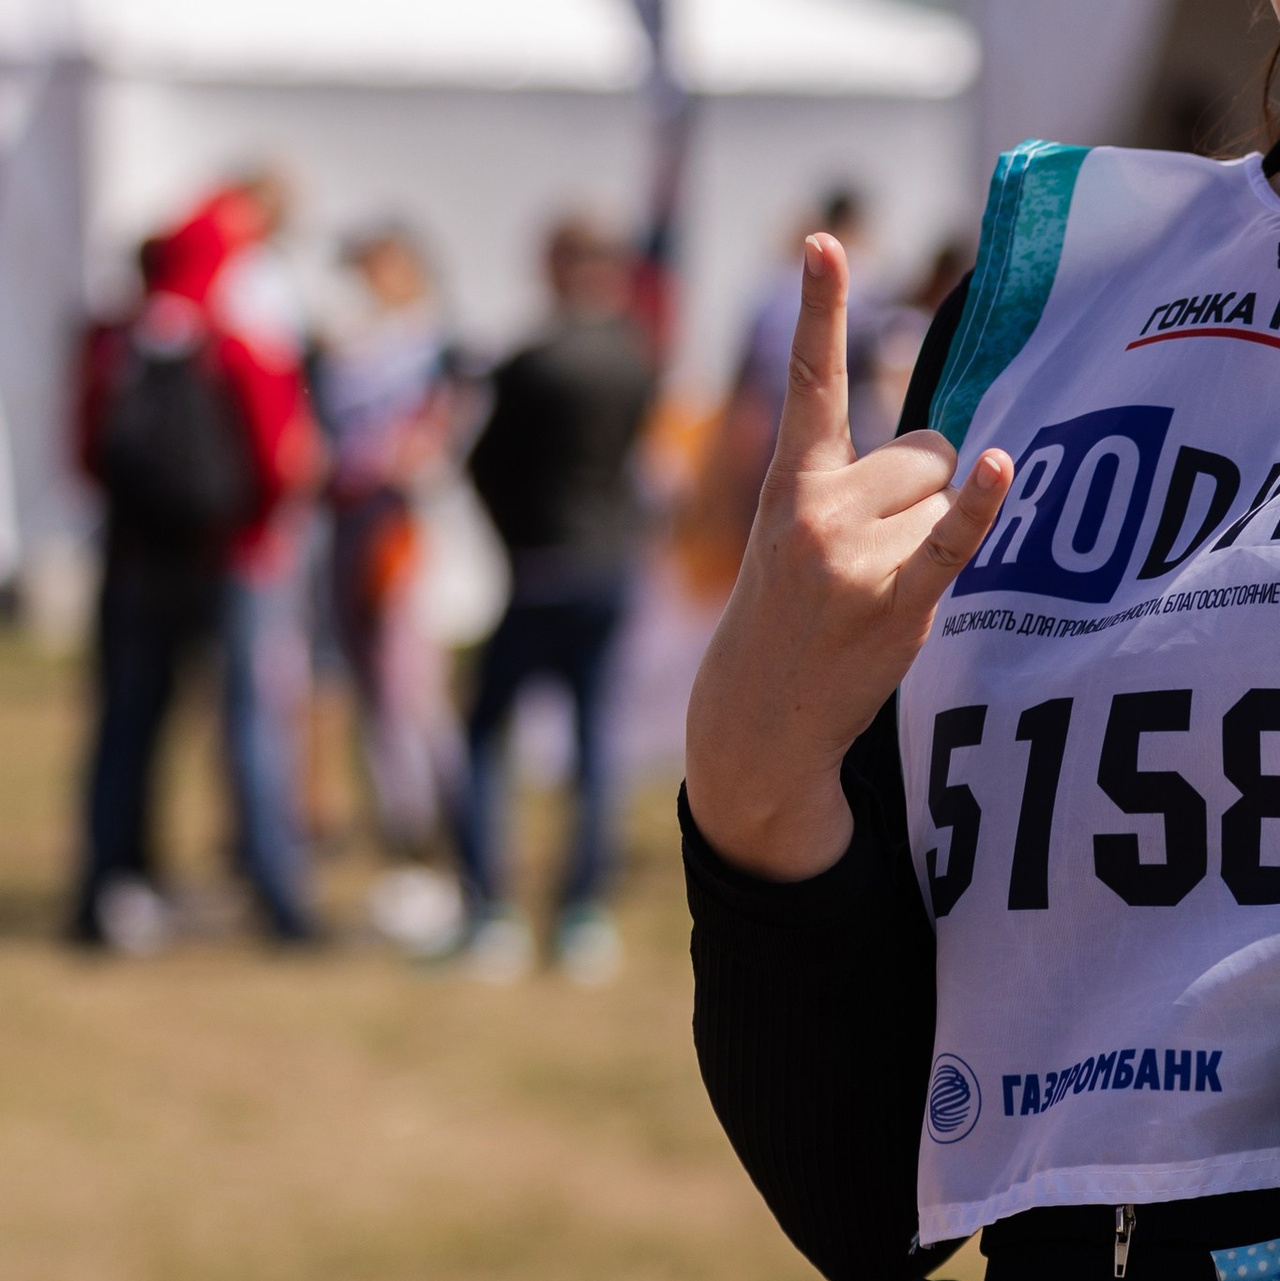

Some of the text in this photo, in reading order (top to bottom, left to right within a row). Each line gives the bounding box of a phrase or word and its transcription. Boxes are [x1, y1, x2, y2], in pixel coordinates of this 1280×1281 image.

[1139, 291, 1257, 336] ГОНКА
[942, 609, 1016, 637] НАДЕЖНОСТЬ
[1016, 613, 1056, 637] ДЛЯ
[1002, 1048, 1223, 1117] ГАЗПРОМБАНК
